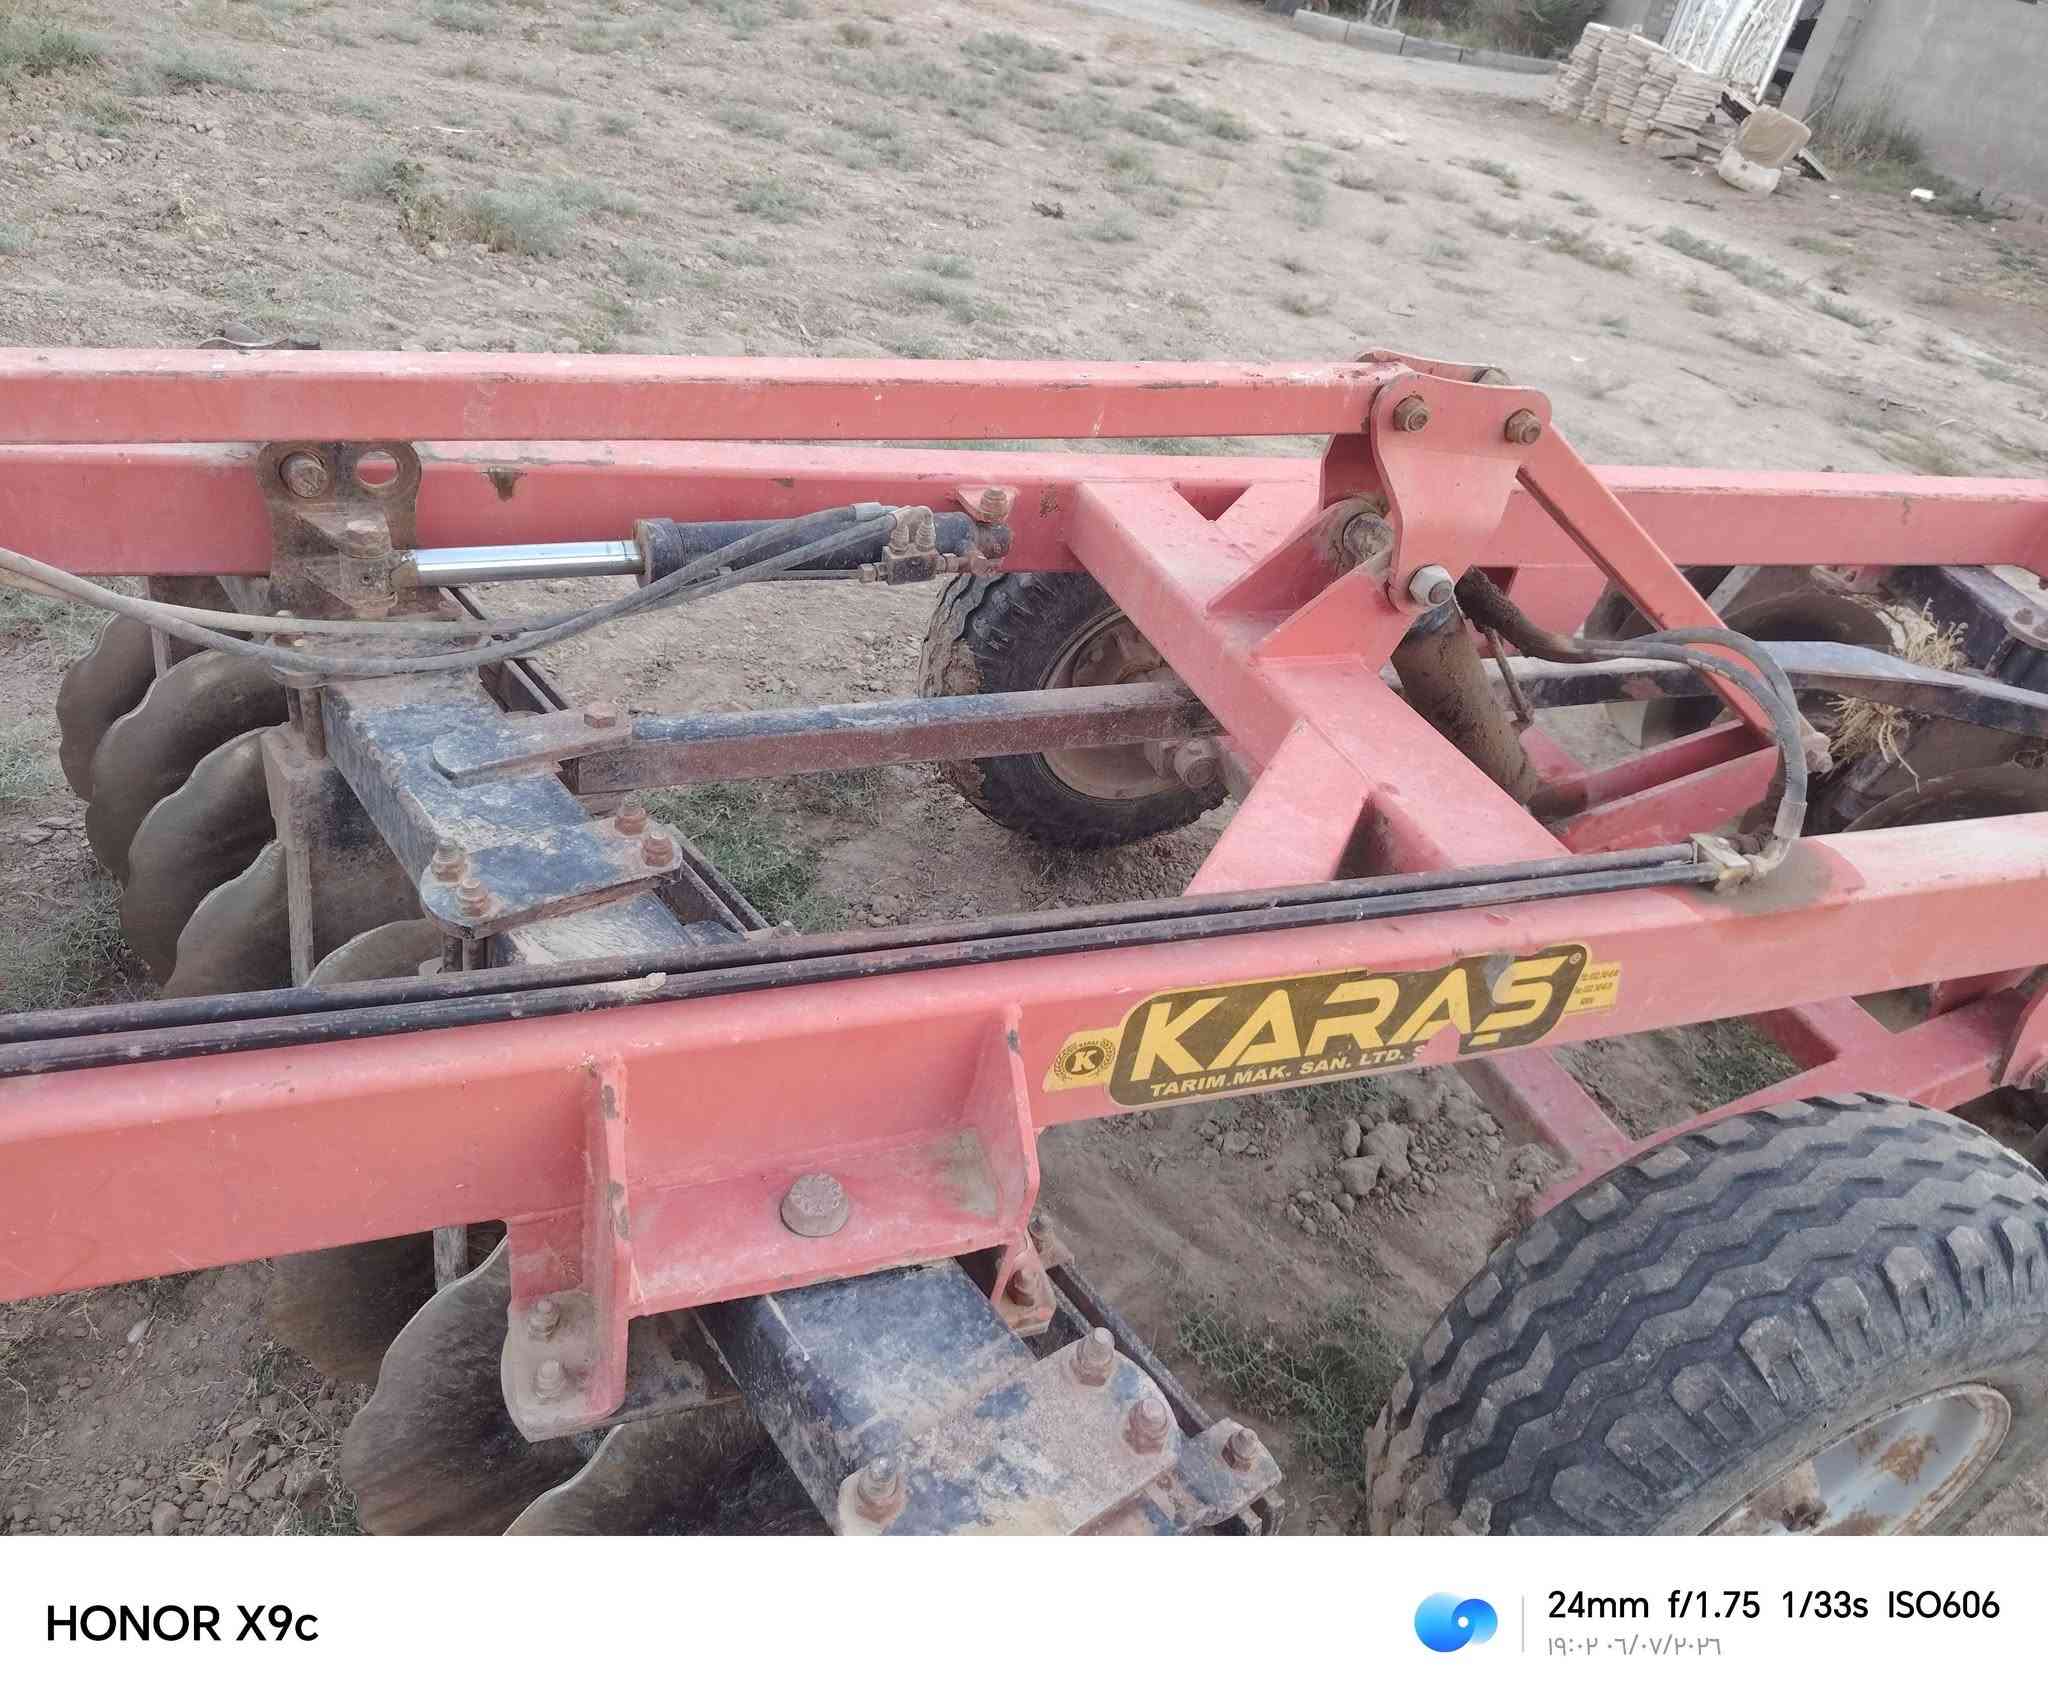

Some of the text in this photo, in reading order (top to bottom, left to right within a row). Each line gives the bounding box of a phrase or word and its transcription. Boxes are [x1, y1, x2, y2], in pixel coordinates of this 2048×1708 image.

[1131, 954, 1570, 1082] KARAŞ
[1071, 1049, 1098, 1073] K
[1299, 1056, 1352, 1075] SAN.
[1359, 1048, 1404, 1067] LTD.
